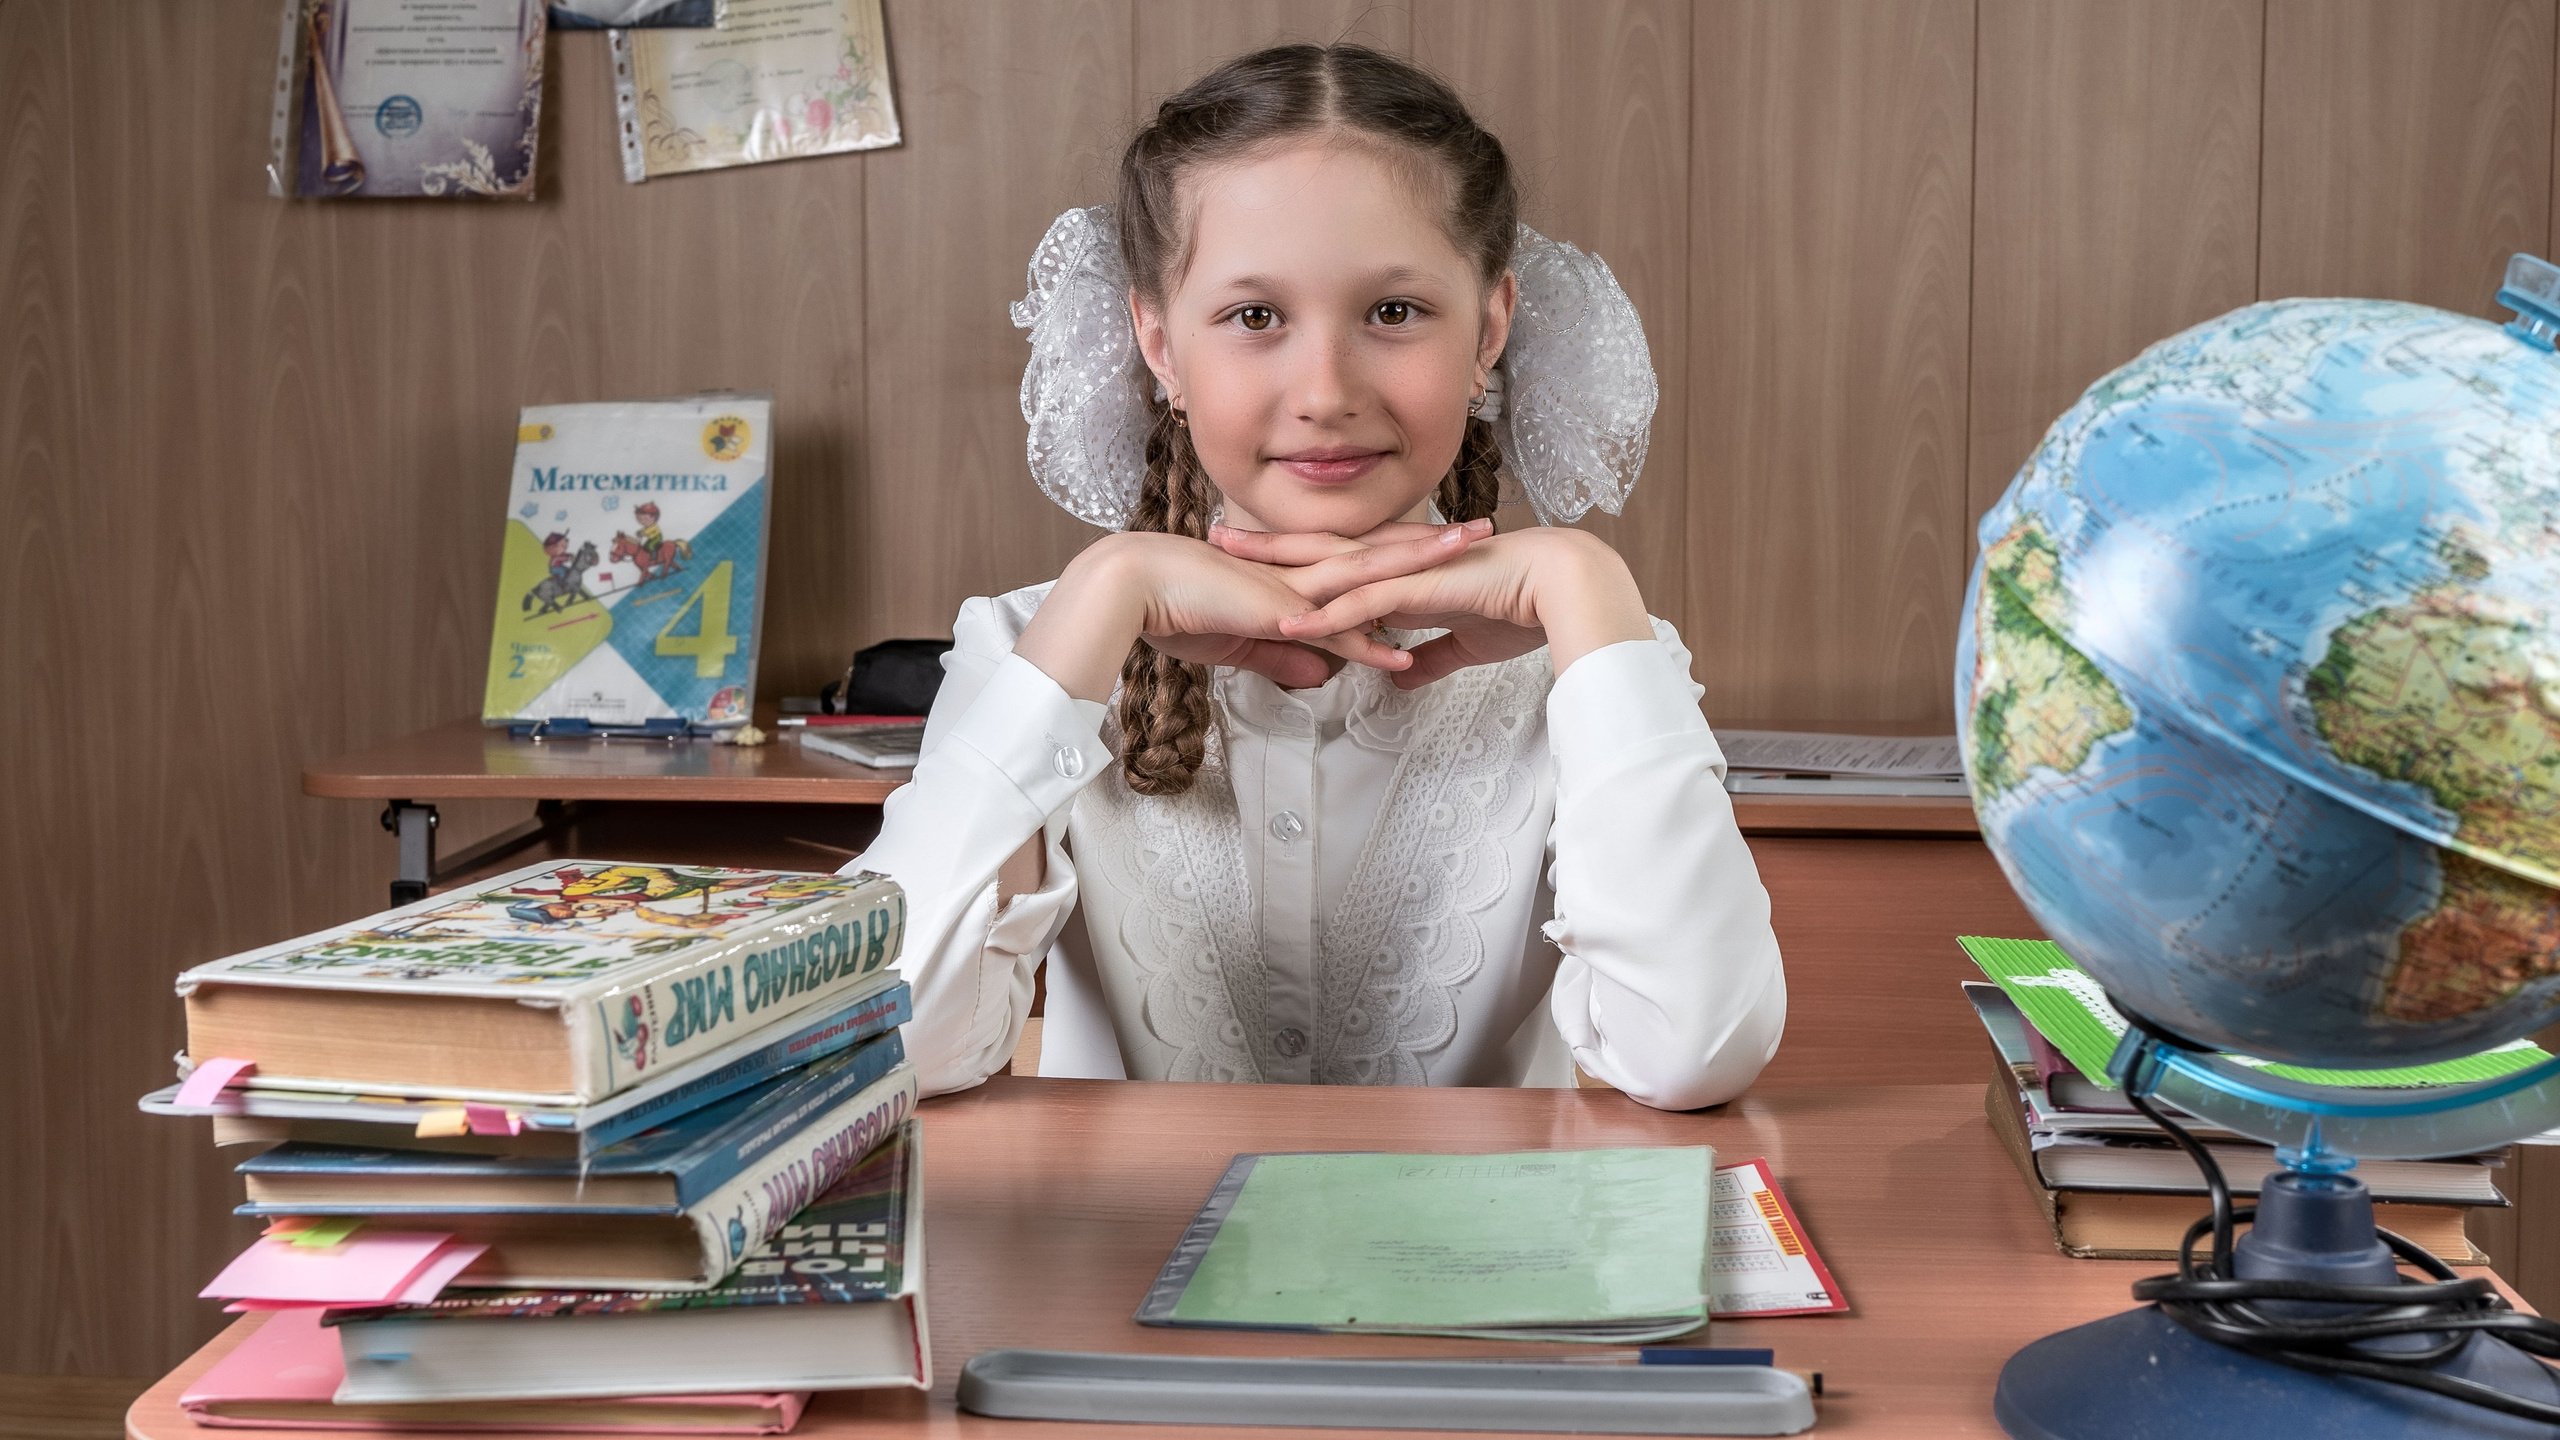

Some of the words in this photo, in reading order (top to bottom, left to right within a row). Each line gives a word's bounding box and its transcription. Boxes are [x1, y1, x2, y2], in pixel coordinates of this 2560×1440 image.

[529, 466, 728, 493] Математика
[654, 559, 738, 678] 4
[508, 653, 526, 679] 2
[862, 908, 890, 975] Я
[743, 919, 861, 1014] ПОЗНАЮ
[665, 964, 735, 1048] МИР
[788, 1021, 846, 1053] РАЗРАБОТКИ
[782, 1223, 887, 1239] ПИ
[751, 1240, 887, 1258] ЧИТ
[741, 1258, 886, 1277] ГОВ
